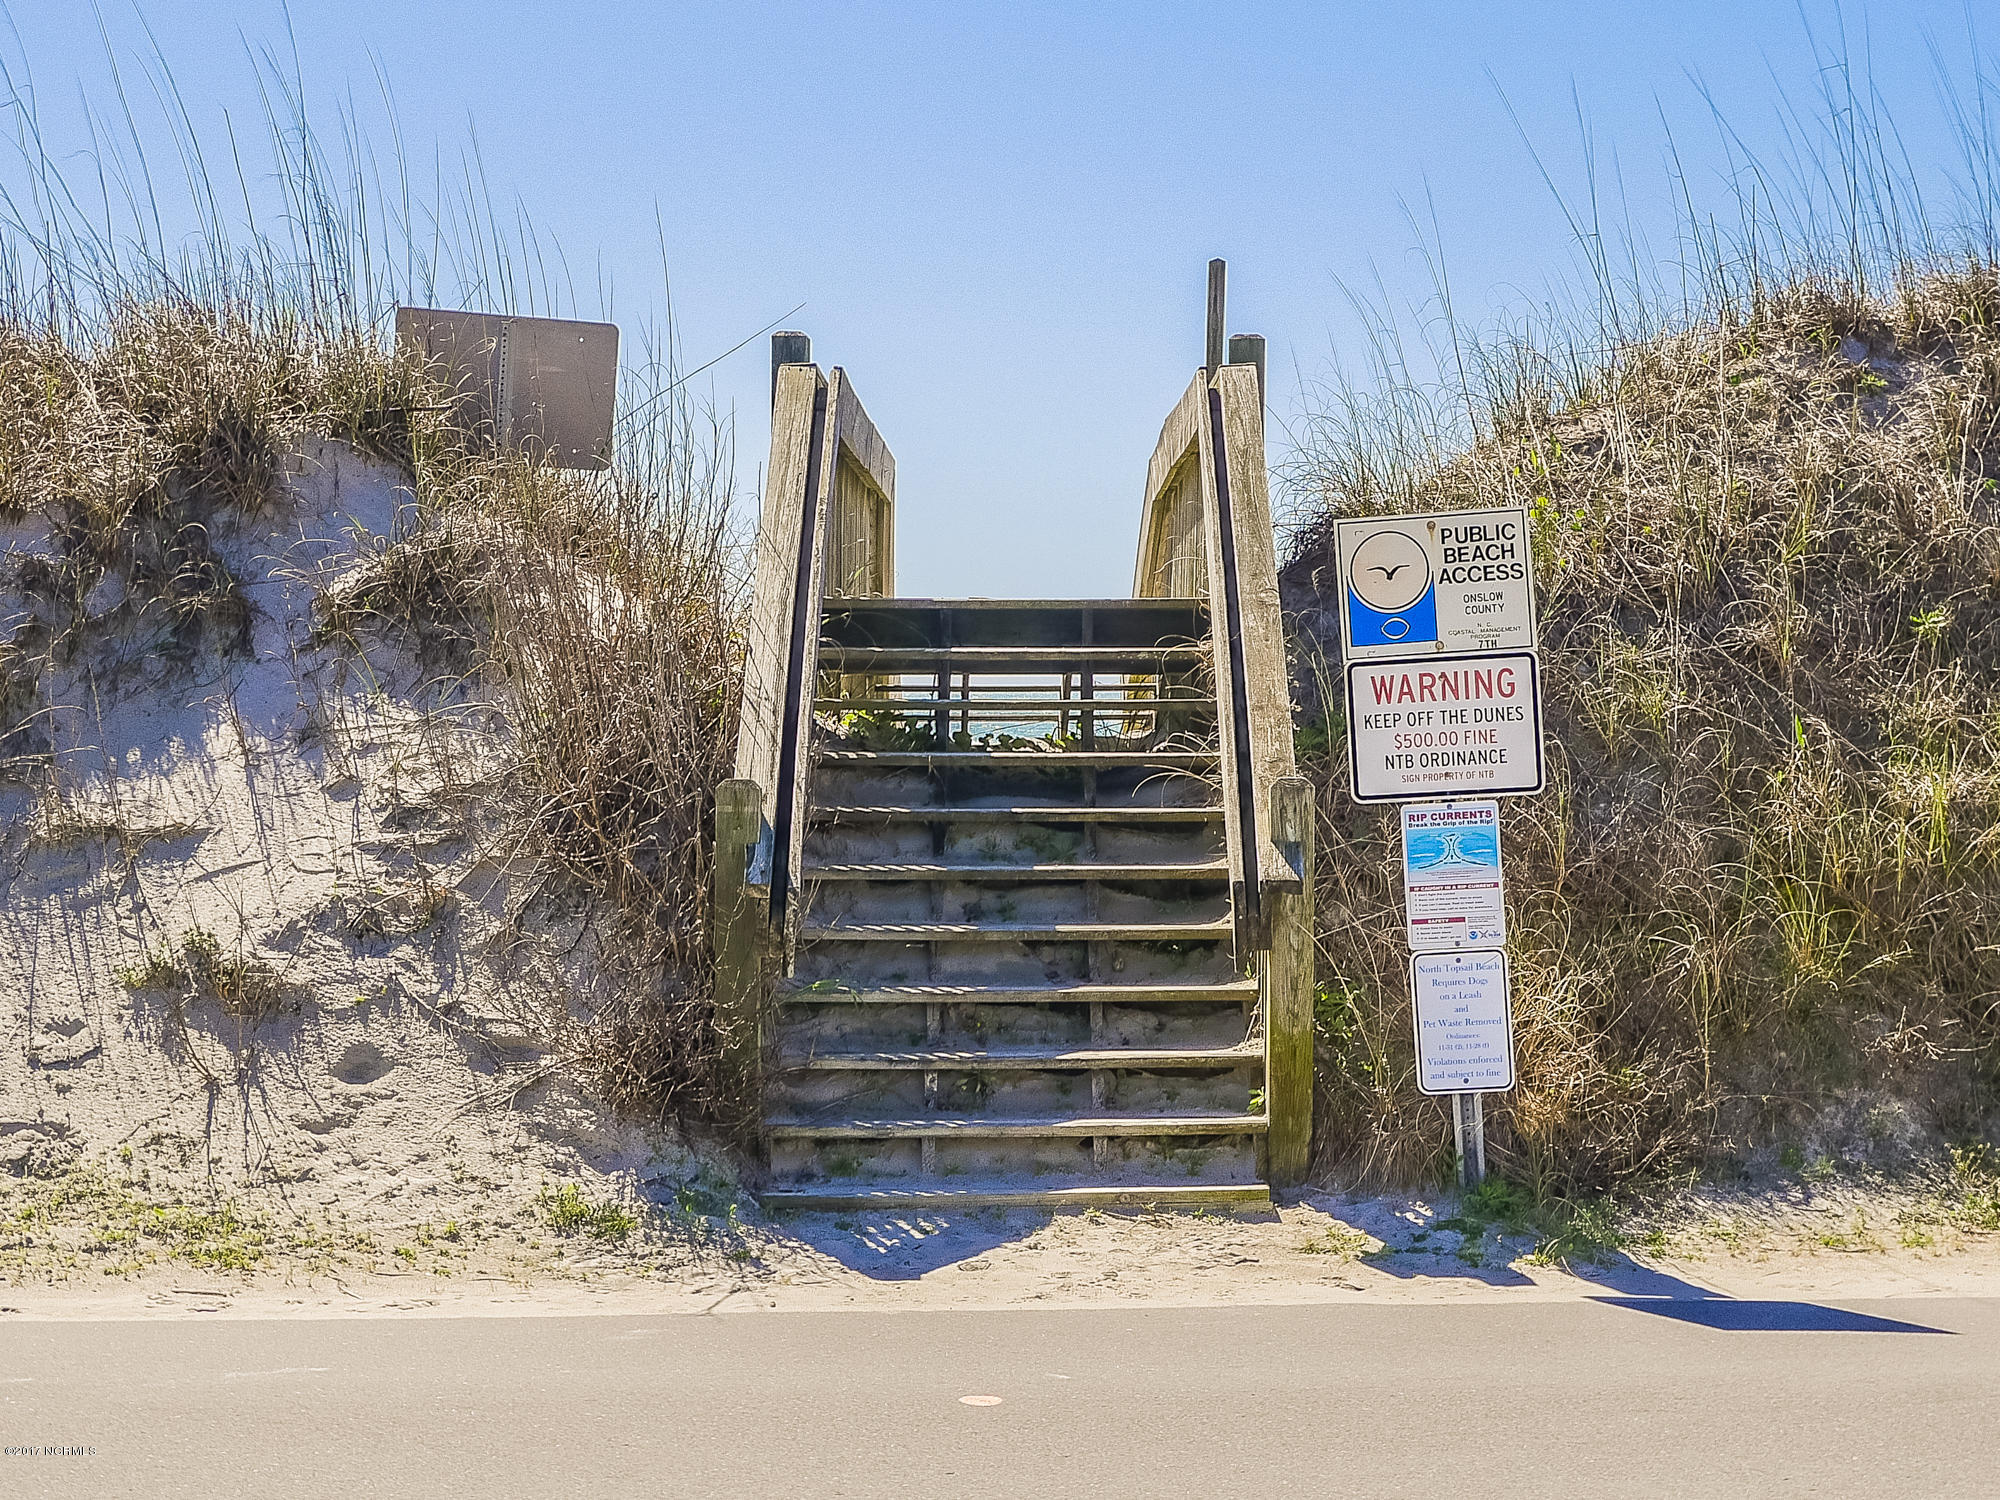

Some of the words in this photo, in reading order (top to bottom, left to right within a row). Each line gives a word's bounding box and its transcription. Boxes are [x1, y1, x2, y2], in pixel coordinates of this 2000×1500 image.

[1440, 523, 1516, 545] PUBLIC
[1443, 543, 1515, 564] BEACH
[1439, 563, 1524, 585] ACCESS
[1463, 591, 1504, 603] ONSLOW
[1464, 603, 1505, 615] COUNTY
[1478, 639, 1498, 648] 7TH
[1370, 667, 1516, 705] WARNING
[1364, 713, 1402, 730] KEEP
[1406, 710, 1434, 727] OFF
[1439, 708, 1469, 725] THE
[1473, 706, 1524, 723] DUNES
[1394, 730, 1459, 750] $500.00
[1464, 728, 1498, 745] FINE
[1385, 754, 1414, 770] NTB
[1419, 748, 1508, 768] ORDINANCE
[1401, 774, 1420, 783] SIGN
[1422, 771, 1463, 782] PROPERTY
[1466, 771, 1476, 780] OF
[1478, 769, 1495, 779] NTB
[1408, 813, 1427, 822] RIP
[1430, 810, 1492, 821] CURRENTS
[1419, 964, 1442, 974] North
[1444, 963, 1473, 974] Topsail
[1476, 962, 1500, 971] Beach
[1432, 978, 1466, 988] Requires
[1468, 977, 1489, 986] Dogs
[1458, 990, 1482, 999] Leash
[1454, 1004, 1469, 1013] and
[1423, 1020, 1436, 1028] Pet
[1438, 1019, 1463, 1027] Waste
[1465, 1017, 1502, 1026] Removed
[1427, 1057, 1467, 1066] Violations
[1468, 1055, 1503, 1064] enforced
[1447, 1070, 1474, 1080] subject
[1476, 1069, 1484, 1077] to
[1486, 1068, 1501, 1077] fine
